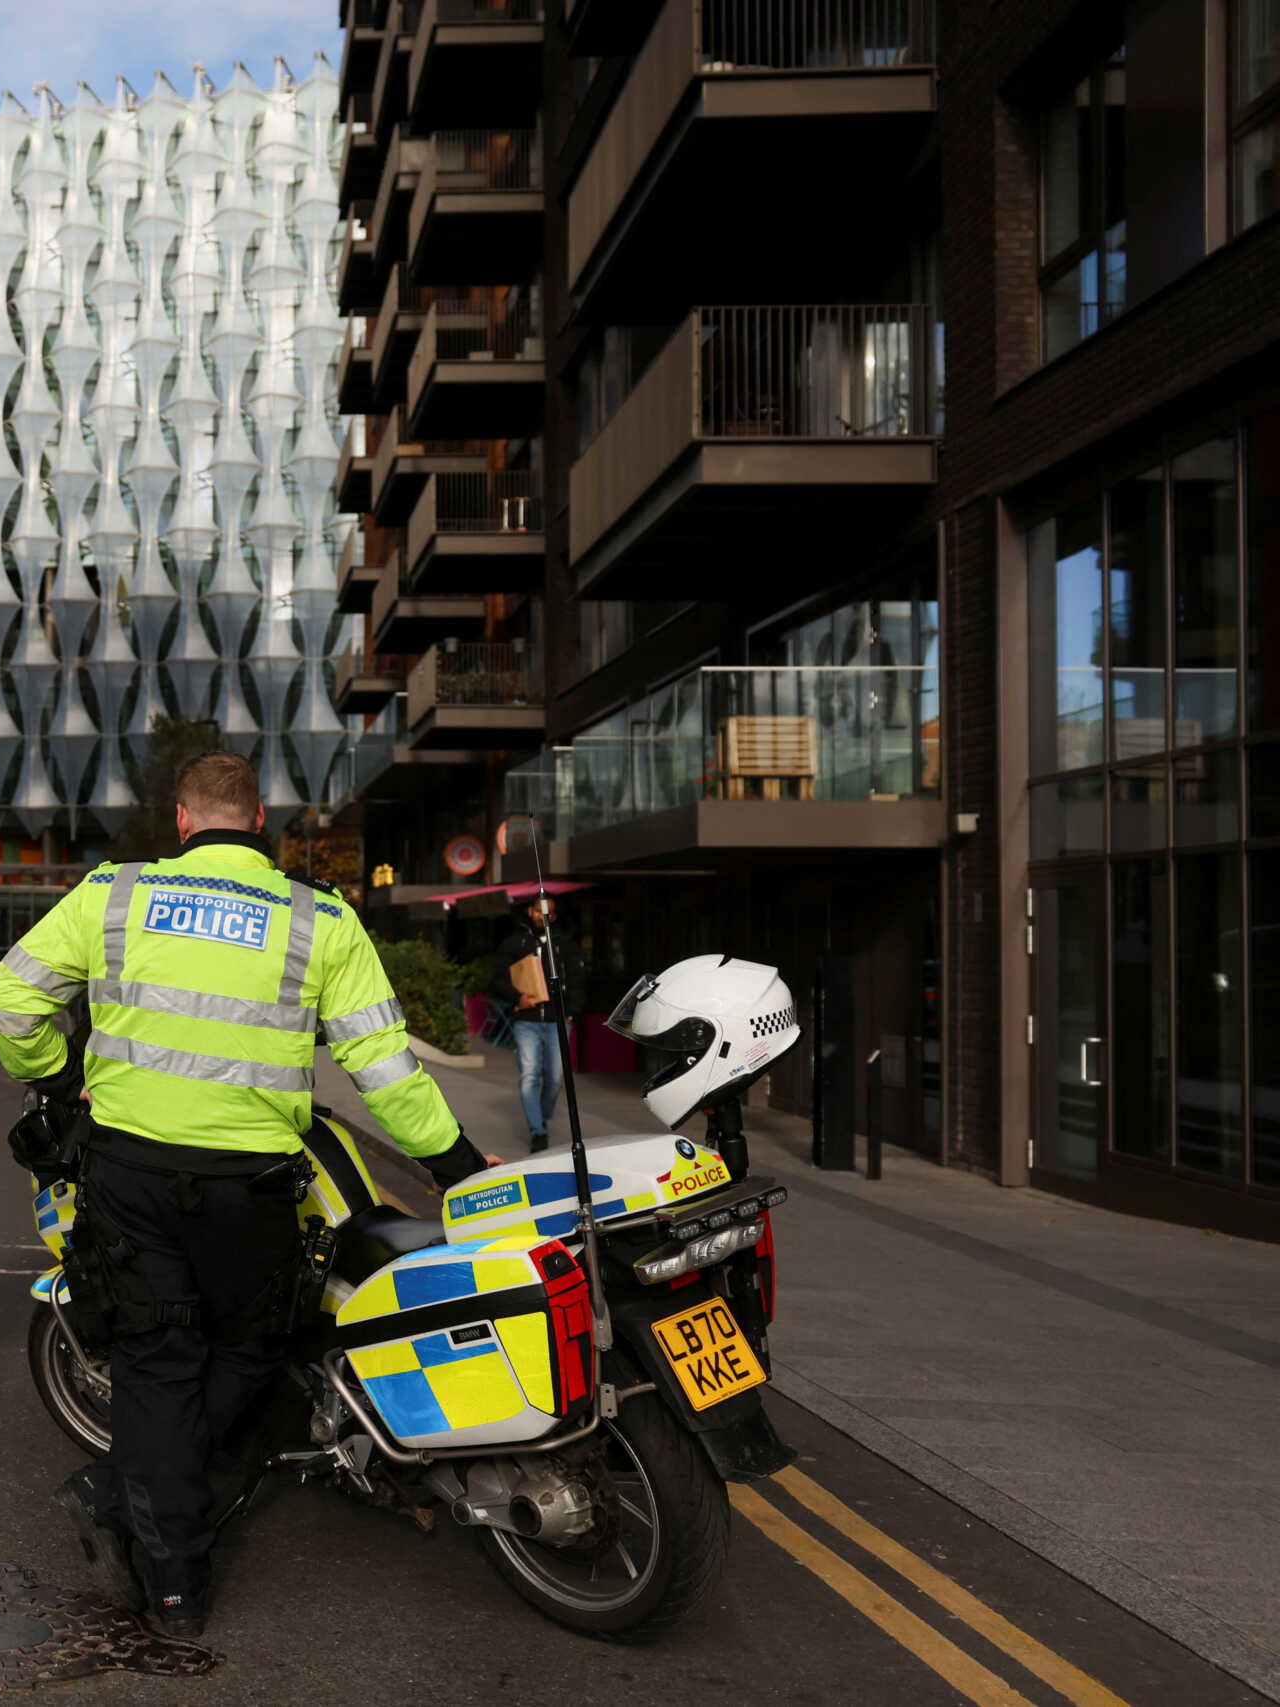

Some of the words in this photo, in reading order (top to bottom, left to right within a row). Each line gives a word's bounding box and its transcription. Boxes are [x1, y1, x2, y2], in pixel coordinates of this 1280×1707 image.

[154, 893, 266, 917] METROPOLITAN
[148, 903, 263, 944] POLICE
[468, 1184, 513, 1201] METROPOLITAN
[671, 1166, 726, 1196] POLICE
[476, 1195, 509, 1210] POLICE
[658, 1306, 736, 1362] LB70
[686, 1344, 750, 1396] KKE
